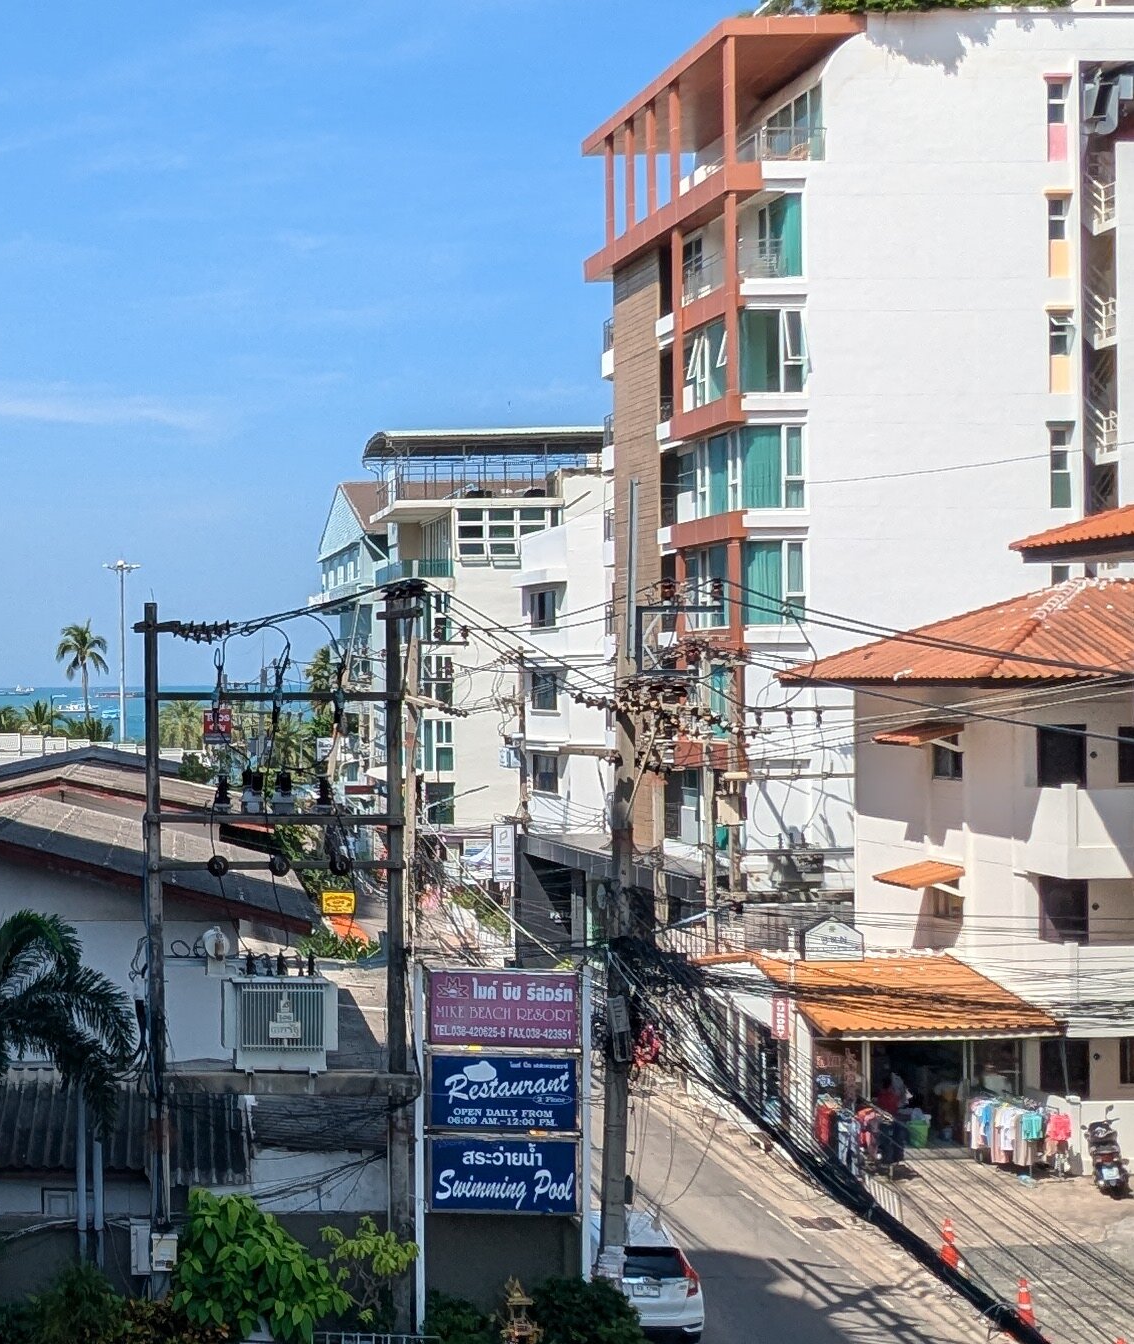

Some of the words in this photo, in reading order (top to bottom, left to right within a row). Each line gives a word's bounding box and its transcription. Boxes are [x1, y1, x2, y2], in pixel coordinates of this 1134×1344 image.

[472, 977, 498, 1000] ไมค์
[502, 982, 521, 1001] บีช
[526, 982, 573, 1002] รีสอร์ท
[436, 1005, 466, 1018] MIKE
[469, 1006, 511, 1020] BEACH
[516, 1007, 574, 1022] RESORT
[444, 1071, 570, 1105] Restaurant
[453, 1107, 482, 1116] OPEN
[485, 1108, 518, 1117] DAILY
[521, 1109, 553, 1118] FROM
[462, 1143, 543, 1166] สระว่ายน้ำ
[435, 1168, 527, 1210] Swimming
[533, 1168, 574, 1204] Pool
